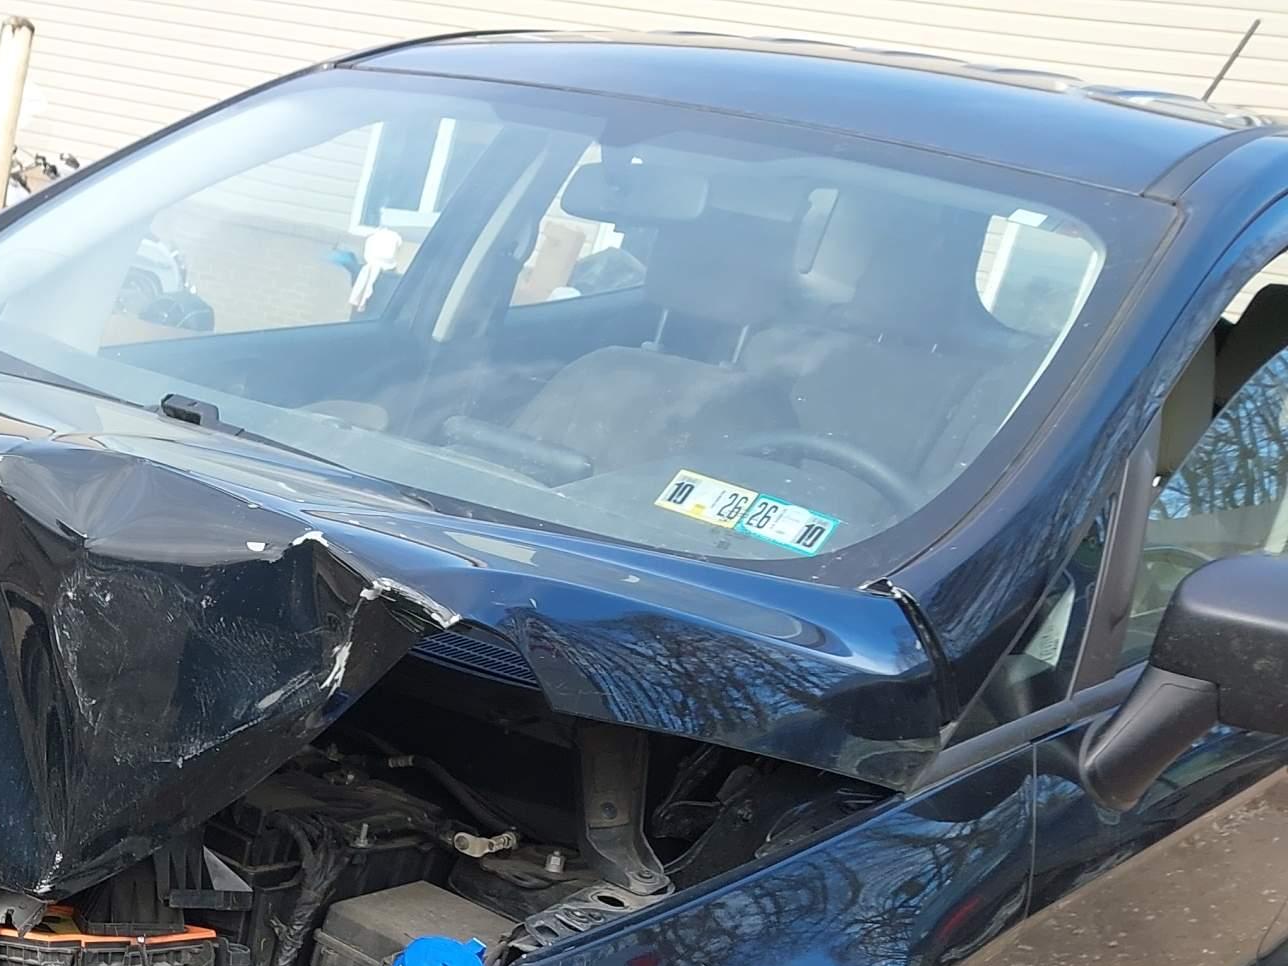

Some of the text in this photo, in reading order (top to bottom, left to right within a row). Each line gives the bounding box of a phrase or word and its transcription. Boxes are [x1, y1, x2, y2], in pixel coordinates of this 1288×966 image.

[667, 481, 696, 505] 10
[717, 493, 749, 520] 26
[746, 501, 779, 529] 26
[796, 523, 826, 548] 10
